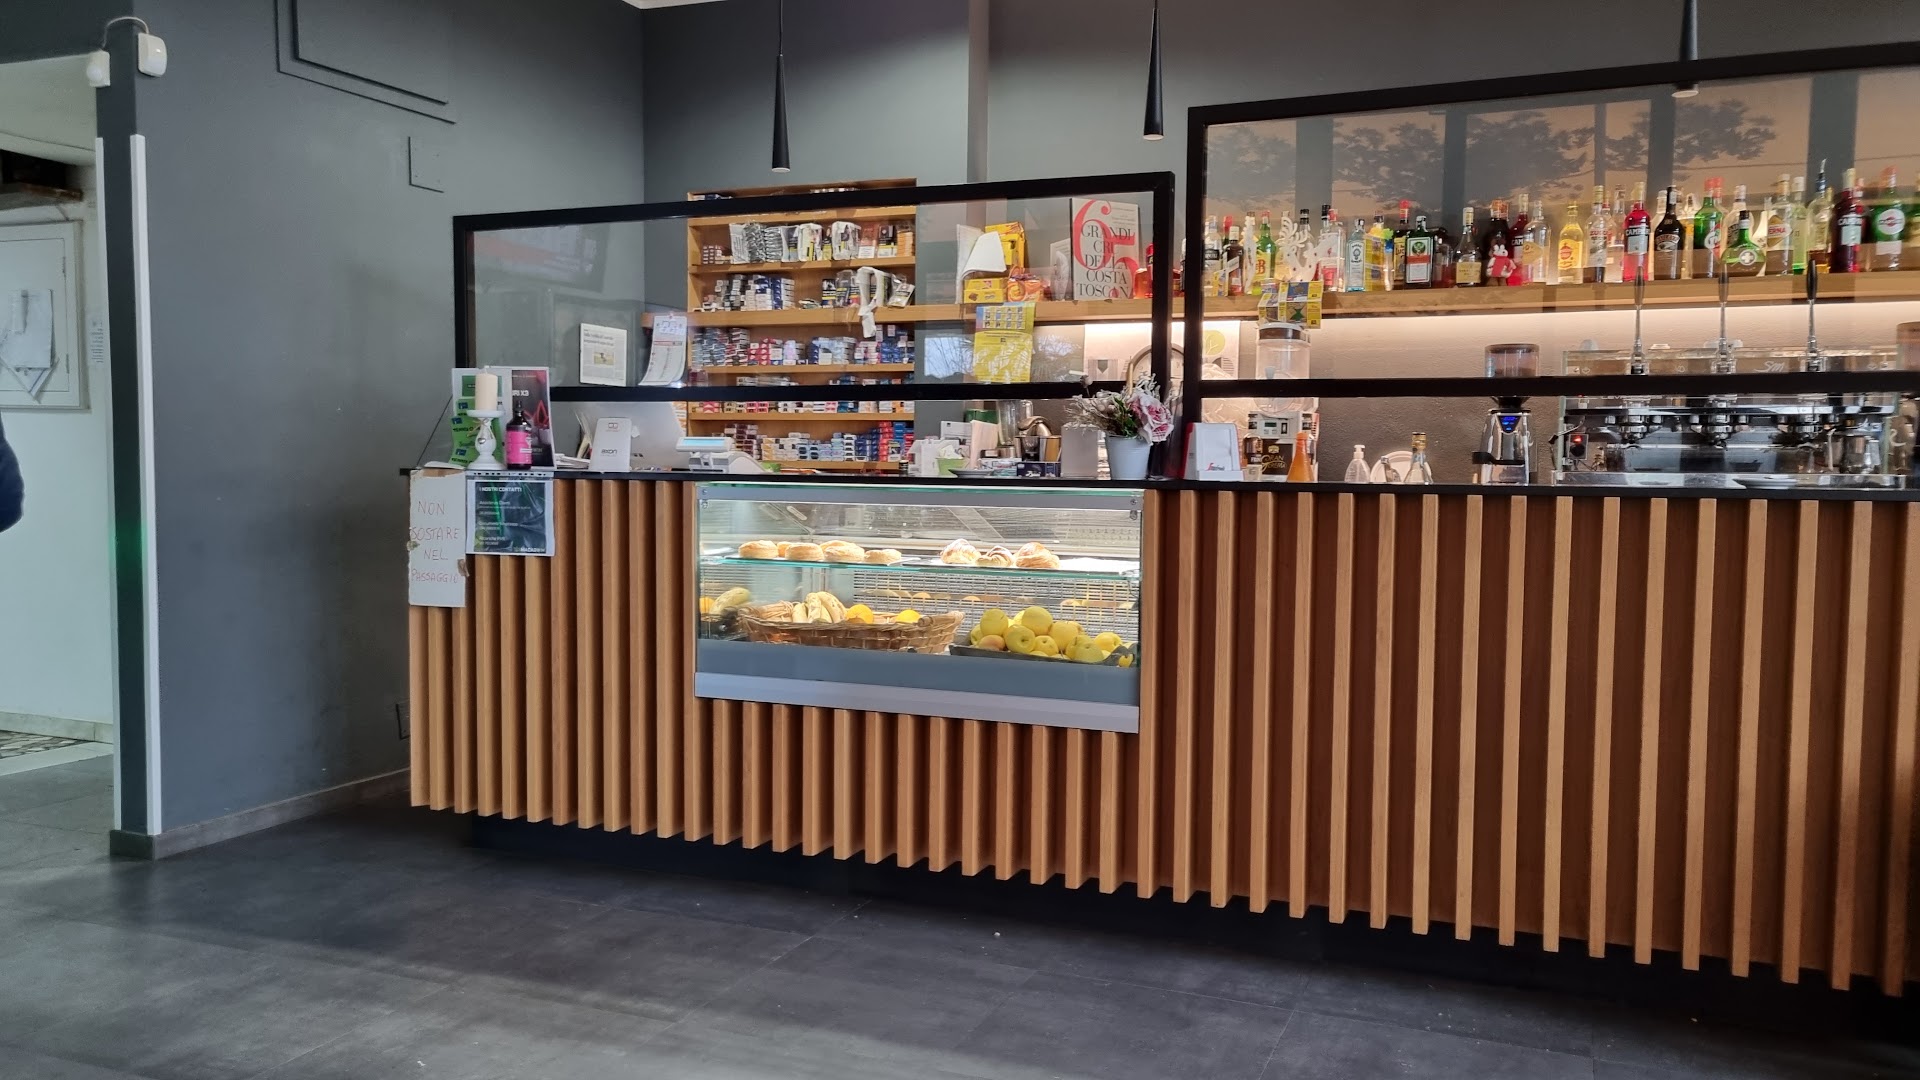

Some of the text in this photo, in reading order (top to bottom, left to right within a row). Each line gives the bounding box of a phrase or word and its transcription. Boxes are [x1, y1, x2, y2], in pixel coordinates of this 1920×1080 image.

[1082, 225, 1132, 241] GRANDI
[1085, 254, 1128, 270] DELLA
[1086, 269, 1127, 285] COSTA
[418, 500, 445, 516] NON
[410, 526, 460, 541] SOSTARE
[423, 549, 449, 561] NEL
[411, 568, 459, 584] PASSAGGIO
